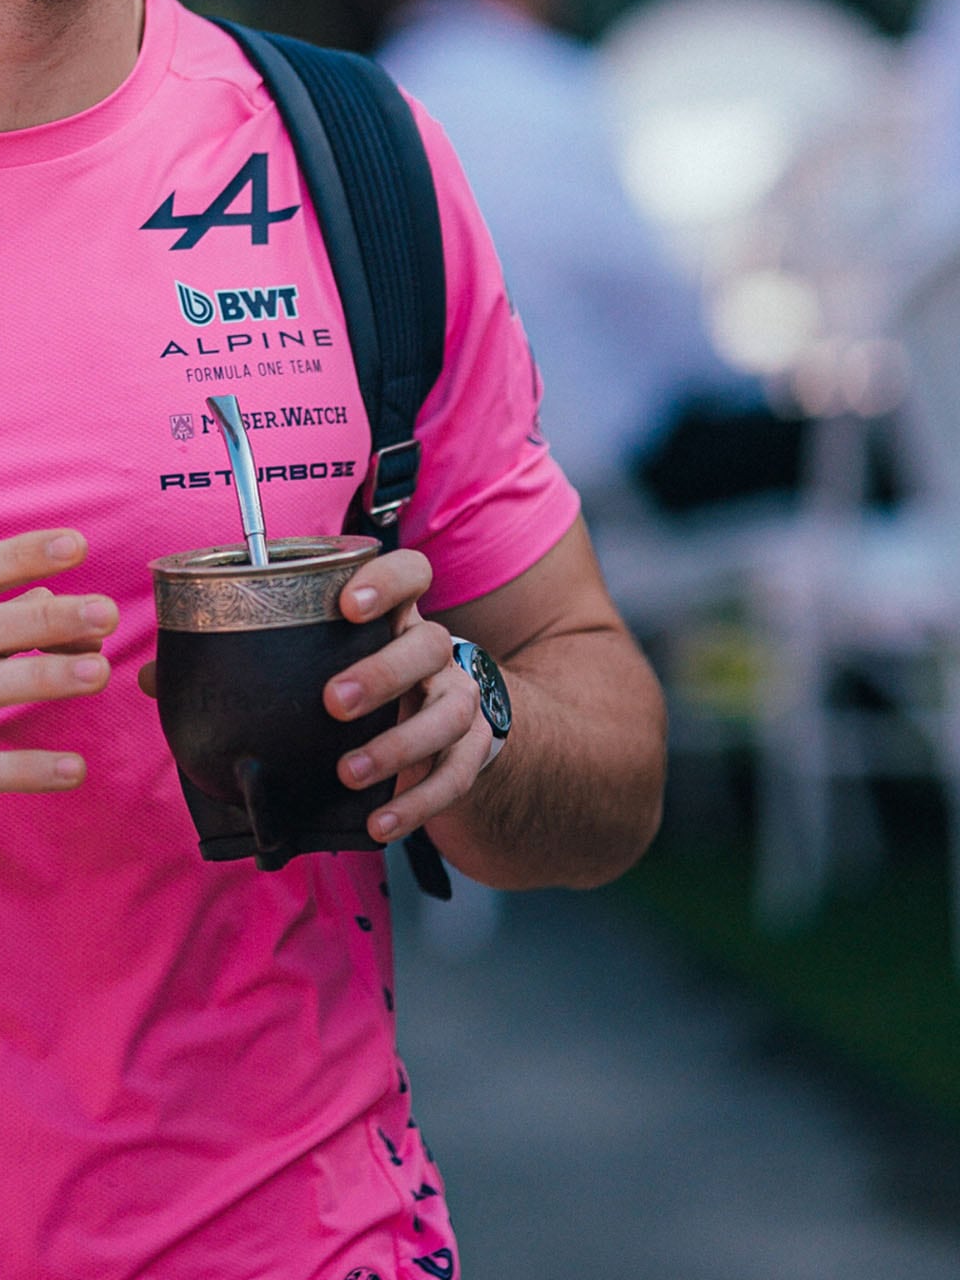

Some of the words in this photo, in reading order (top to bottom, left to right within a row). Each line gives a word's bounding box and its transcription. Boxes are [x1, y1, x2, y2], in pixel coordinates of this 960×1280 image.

[215, 285, 299, 324] BWT
[160, 329, 334, 359] ALPINE
[186, 364, 252, 383] FORMULA
[257, 361, 284, 377] ONE
[290, 359, 323, 374] TEAM
[200, 406, 348, 434] MSER.WATCH
